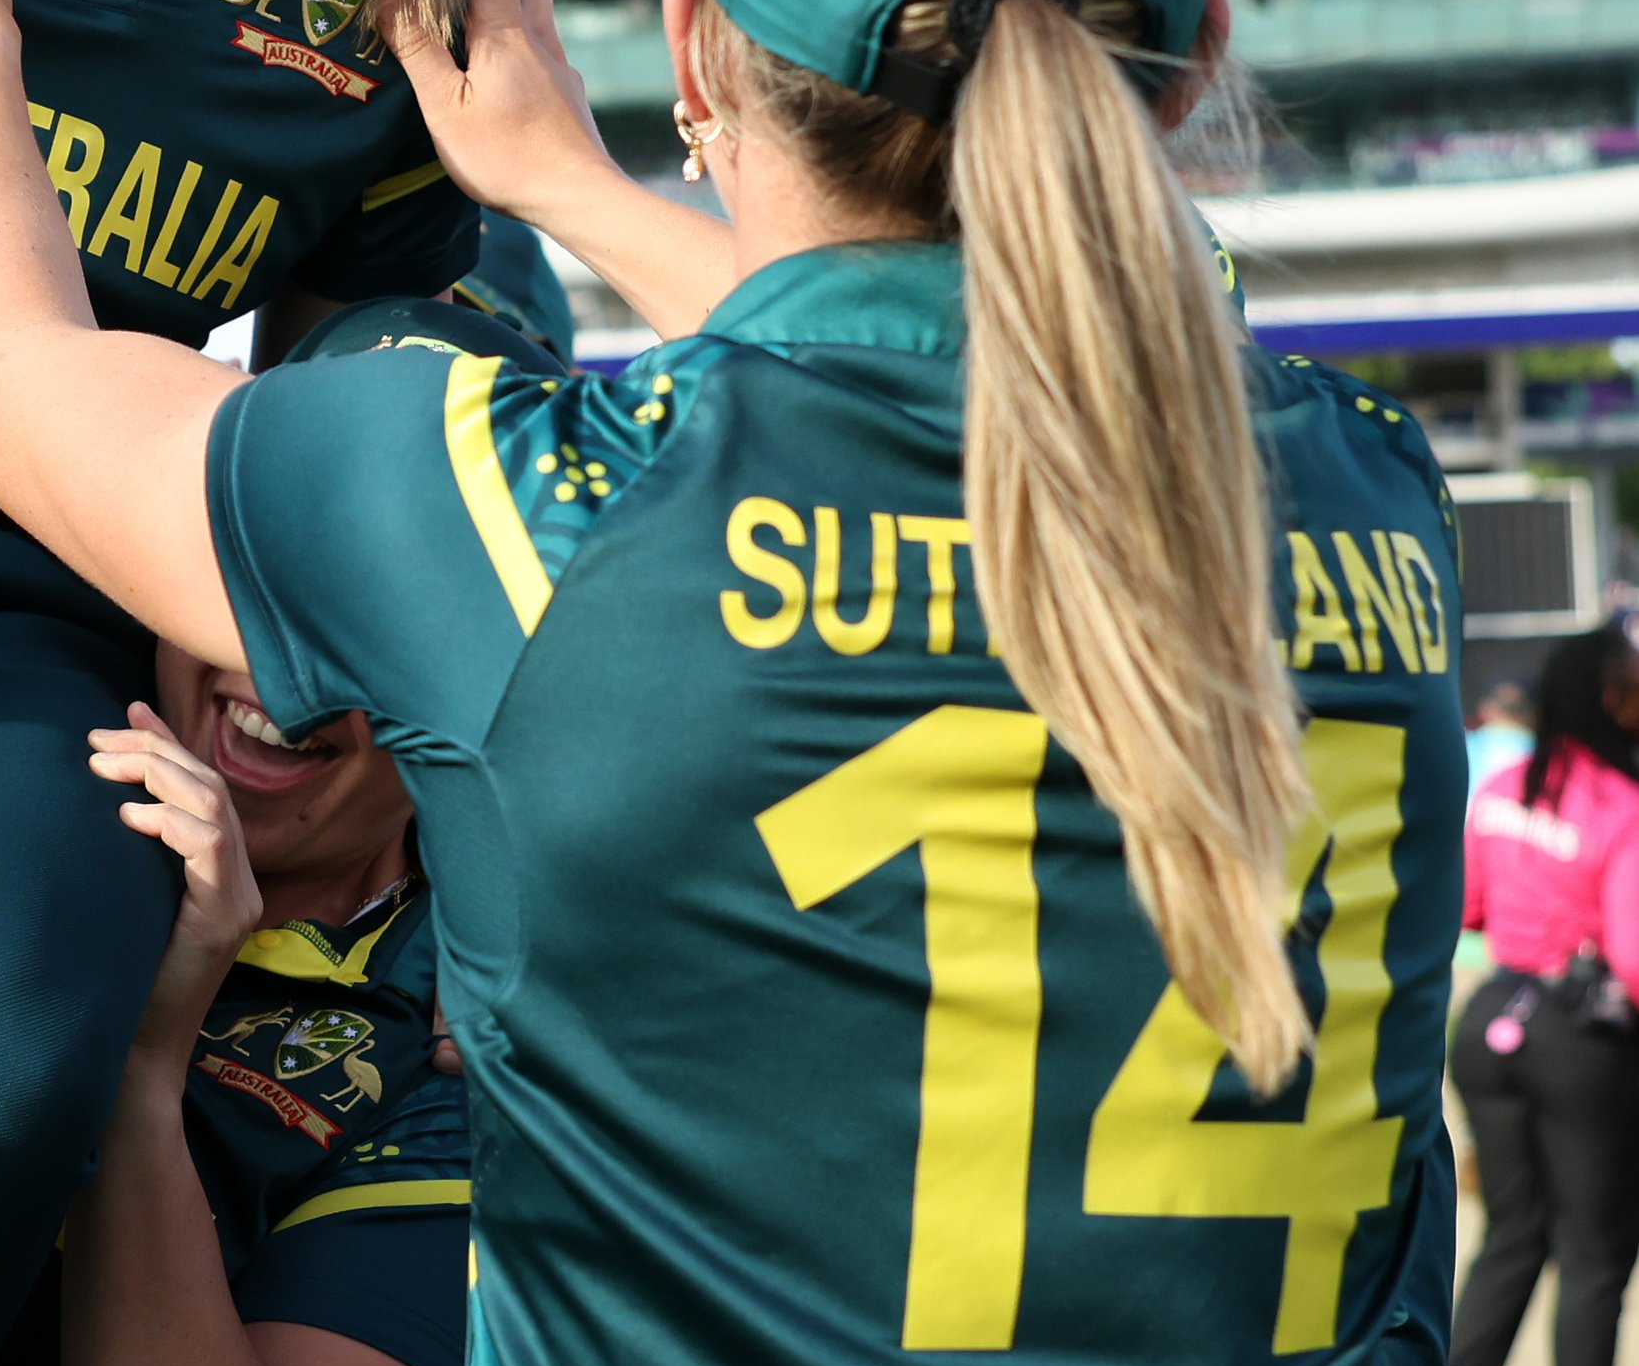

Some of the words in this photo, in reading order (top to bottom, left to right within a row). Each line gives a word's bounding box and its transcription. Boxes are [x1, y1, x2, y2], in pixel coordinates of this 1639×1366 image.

[267, 46, 344, 93] AUSTRALIA
[719, 495, 1449, 675] SUTAND
[754, 703, 1407, 1356] 14
[221, 1068, 302, 1125] AUSTRALIA
